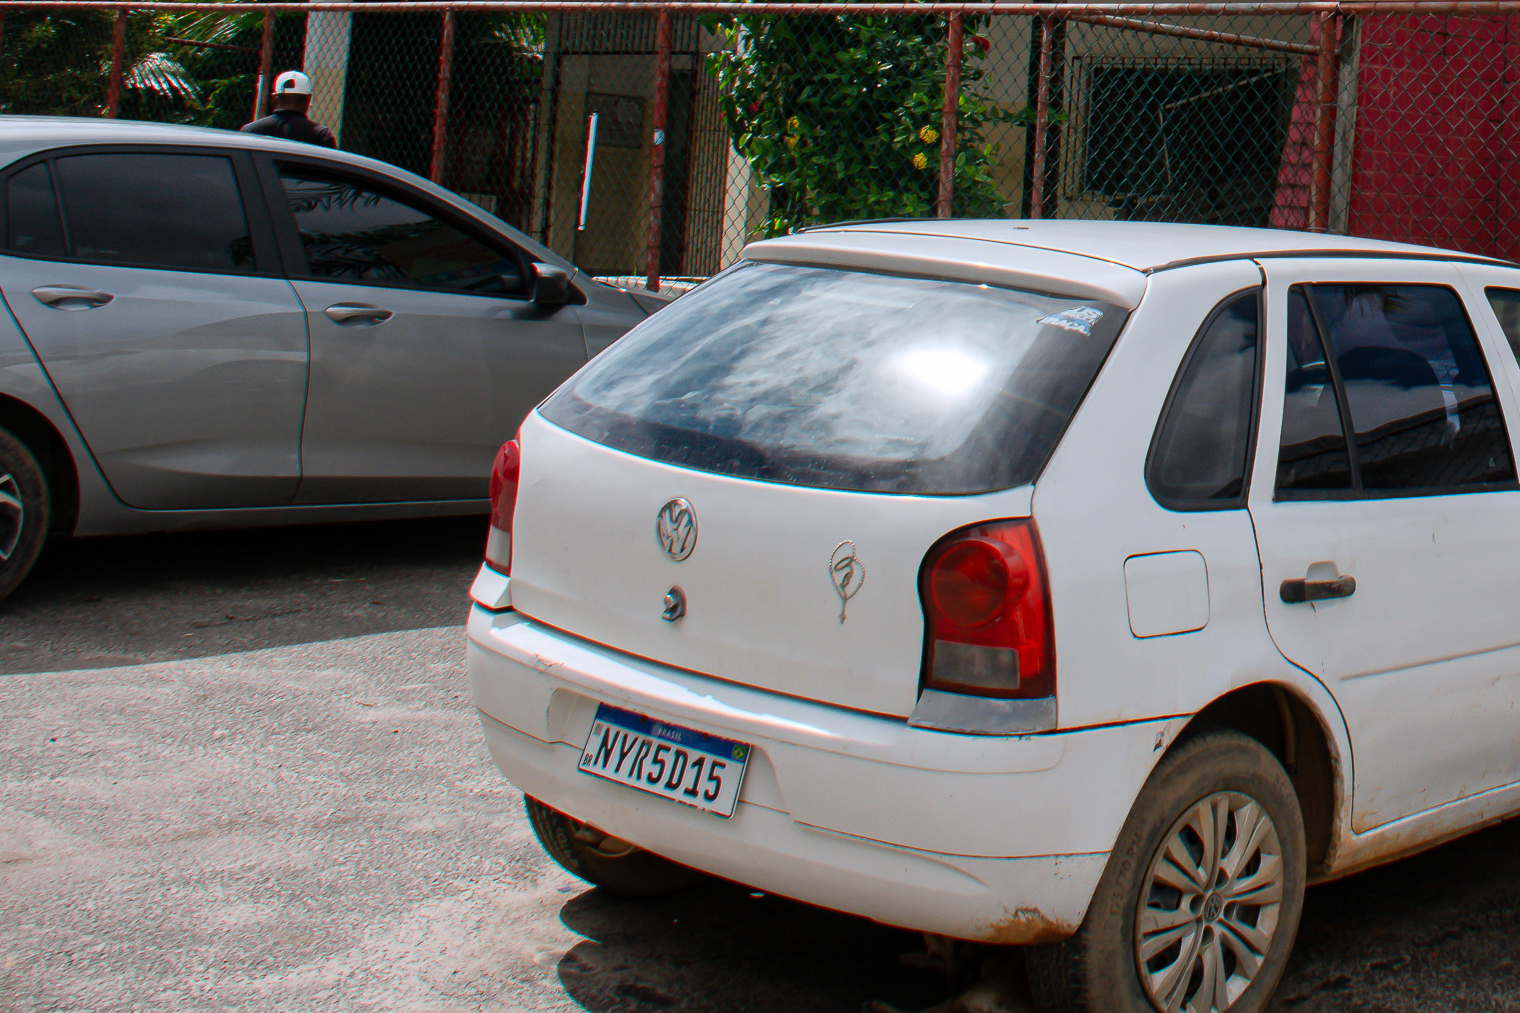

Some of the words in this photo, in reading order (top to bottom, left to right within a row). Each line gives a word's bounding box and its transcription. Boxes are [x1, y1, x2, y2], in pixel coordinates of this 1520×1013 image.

[657, 725, 682, 742] BRASIL
[582, 753, 593, 766] BR
[593, 727, 727, 802] NYR5D15
